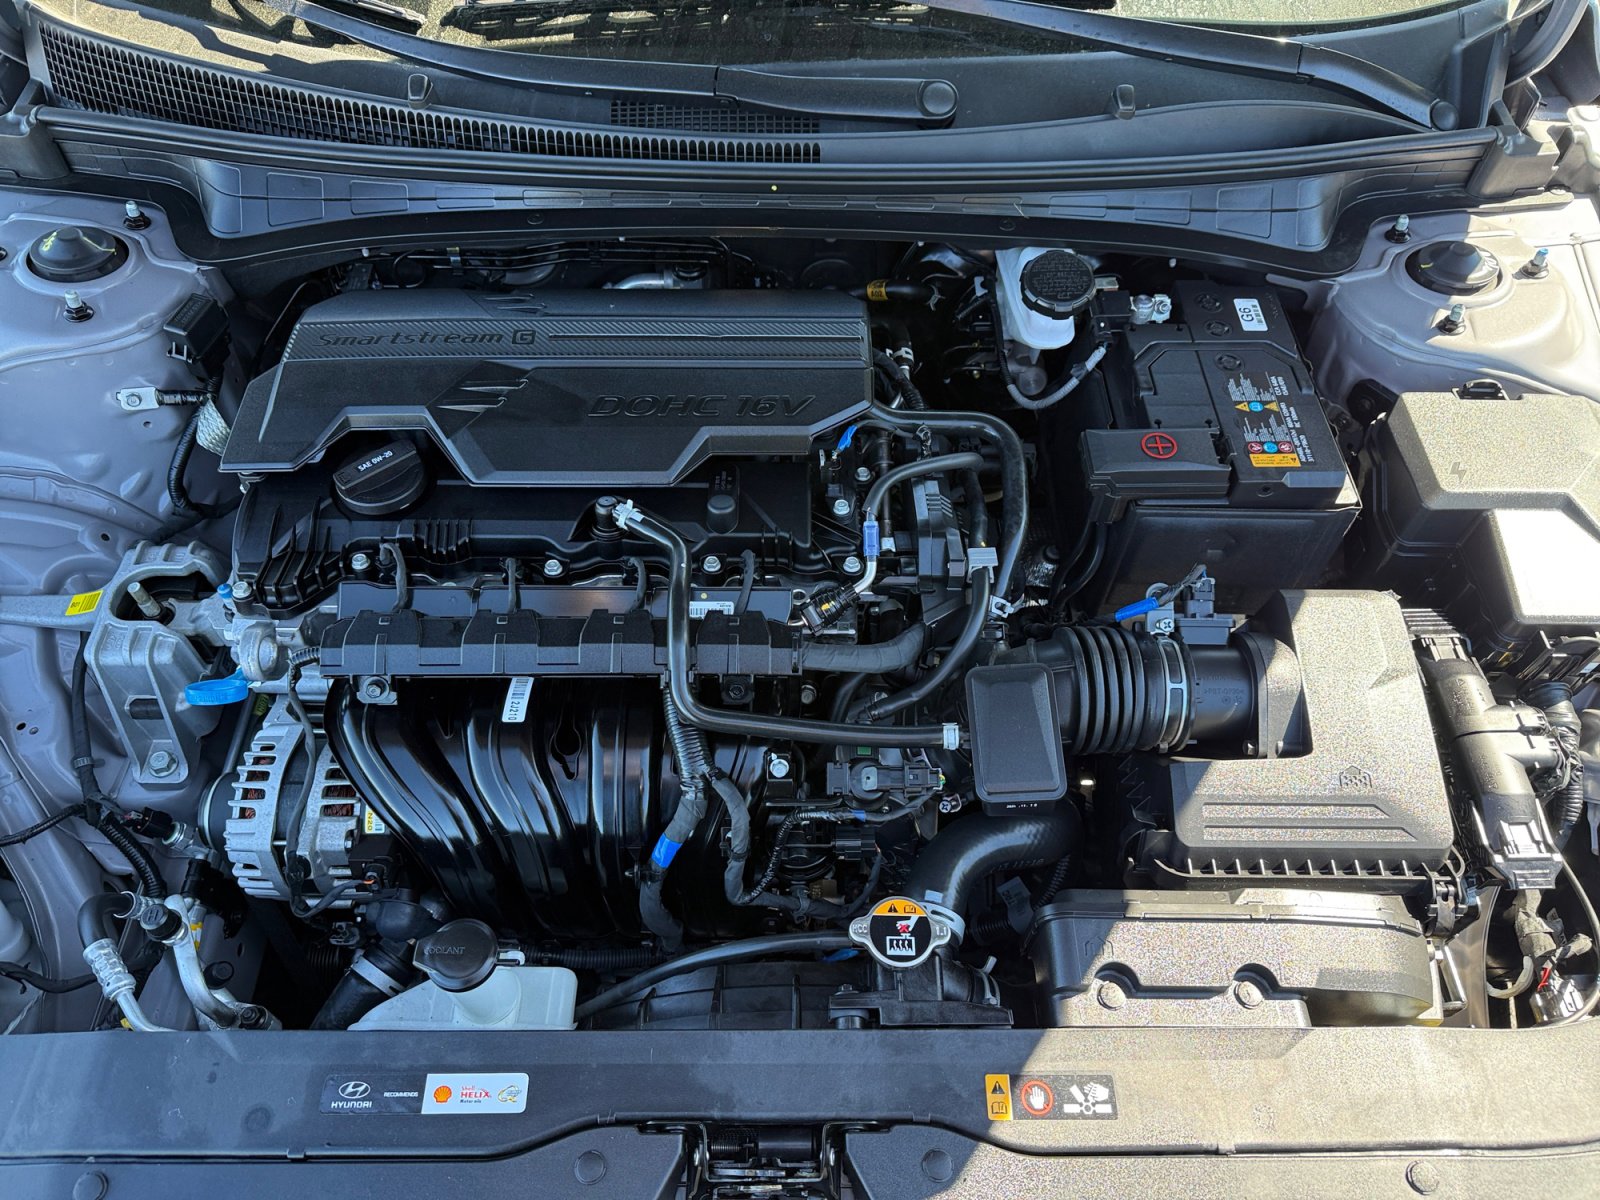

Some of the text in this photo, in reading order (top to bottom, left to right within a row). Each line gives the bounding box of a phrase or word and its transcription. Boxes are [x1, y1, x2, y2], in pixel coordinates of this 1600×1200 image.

[1238, 307, 1254, 322] G6
[312, 329, 536, 347] Smartstream G
[588, 394, 816, 417] DOHC 16V
[357, 450, 393, 472] SAE 0W-20
[147, 909, 159, 921] H
[331, 1101, 373, 1109] HYUNDAI
